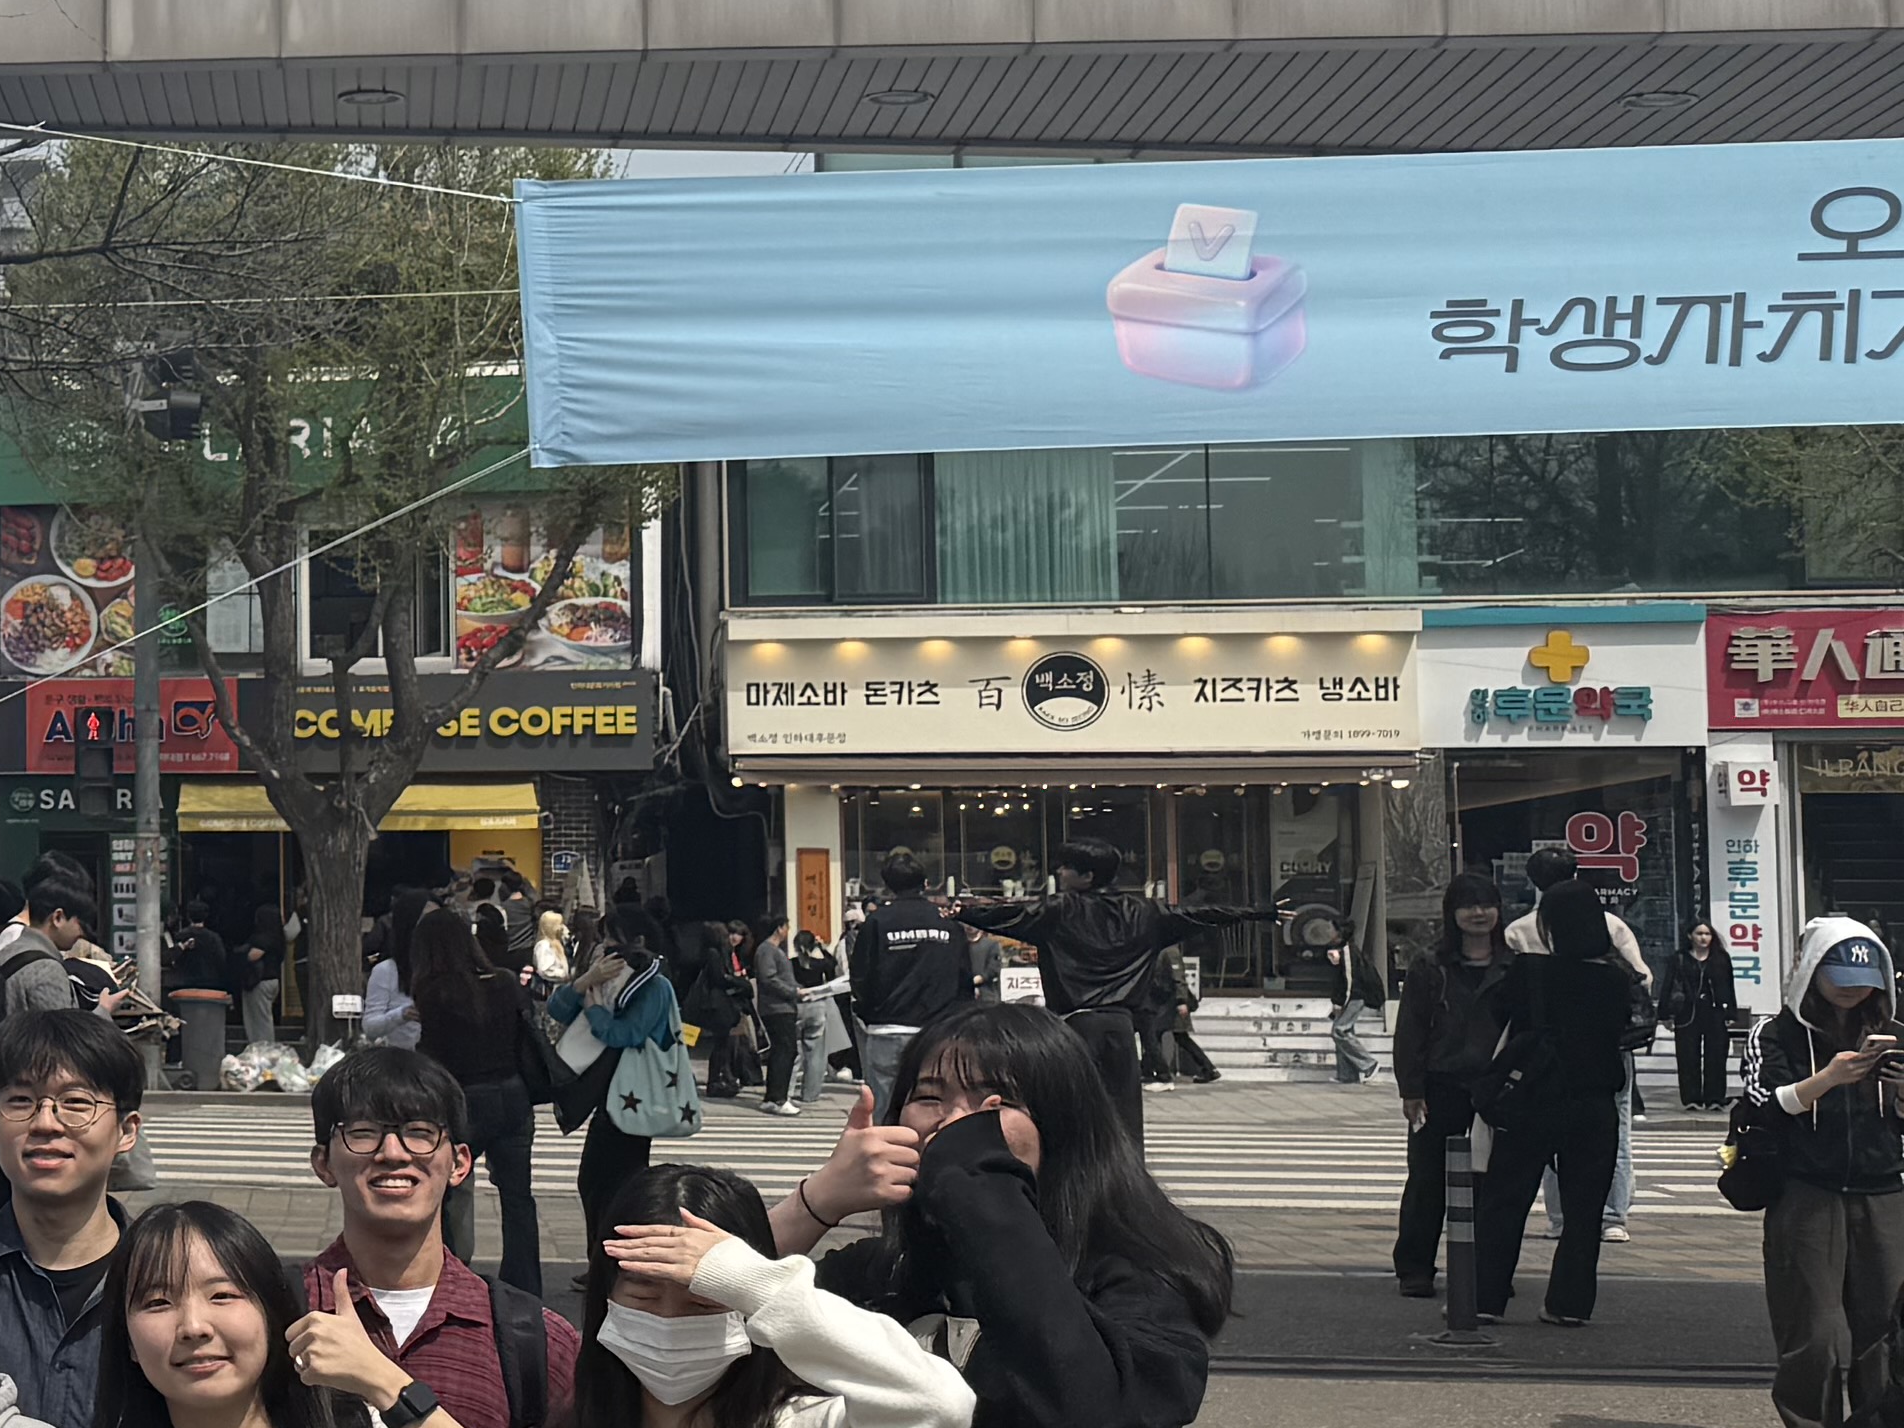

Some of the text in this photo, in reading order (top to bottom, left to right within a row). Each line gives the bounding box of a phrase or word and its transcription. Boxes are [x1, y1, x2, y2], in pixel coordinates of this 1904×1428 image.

[745, 679, 941, 707] 마제소바 돈카츠
[968, 675, 1012, 712] 百
[1035, 670, 1094, 692] 백소정
[1193, 675, 1401, 703] 치즈카츠 냉소바
[1492, 685, 1654, 723] 후문약국
[293, 705, 639, 740] COMSE COFFEE
[1737, 769, 1771, 798] 약
[1566, 811, 1648, 882] 약
[1725, 838, 1760, 855] 인하
